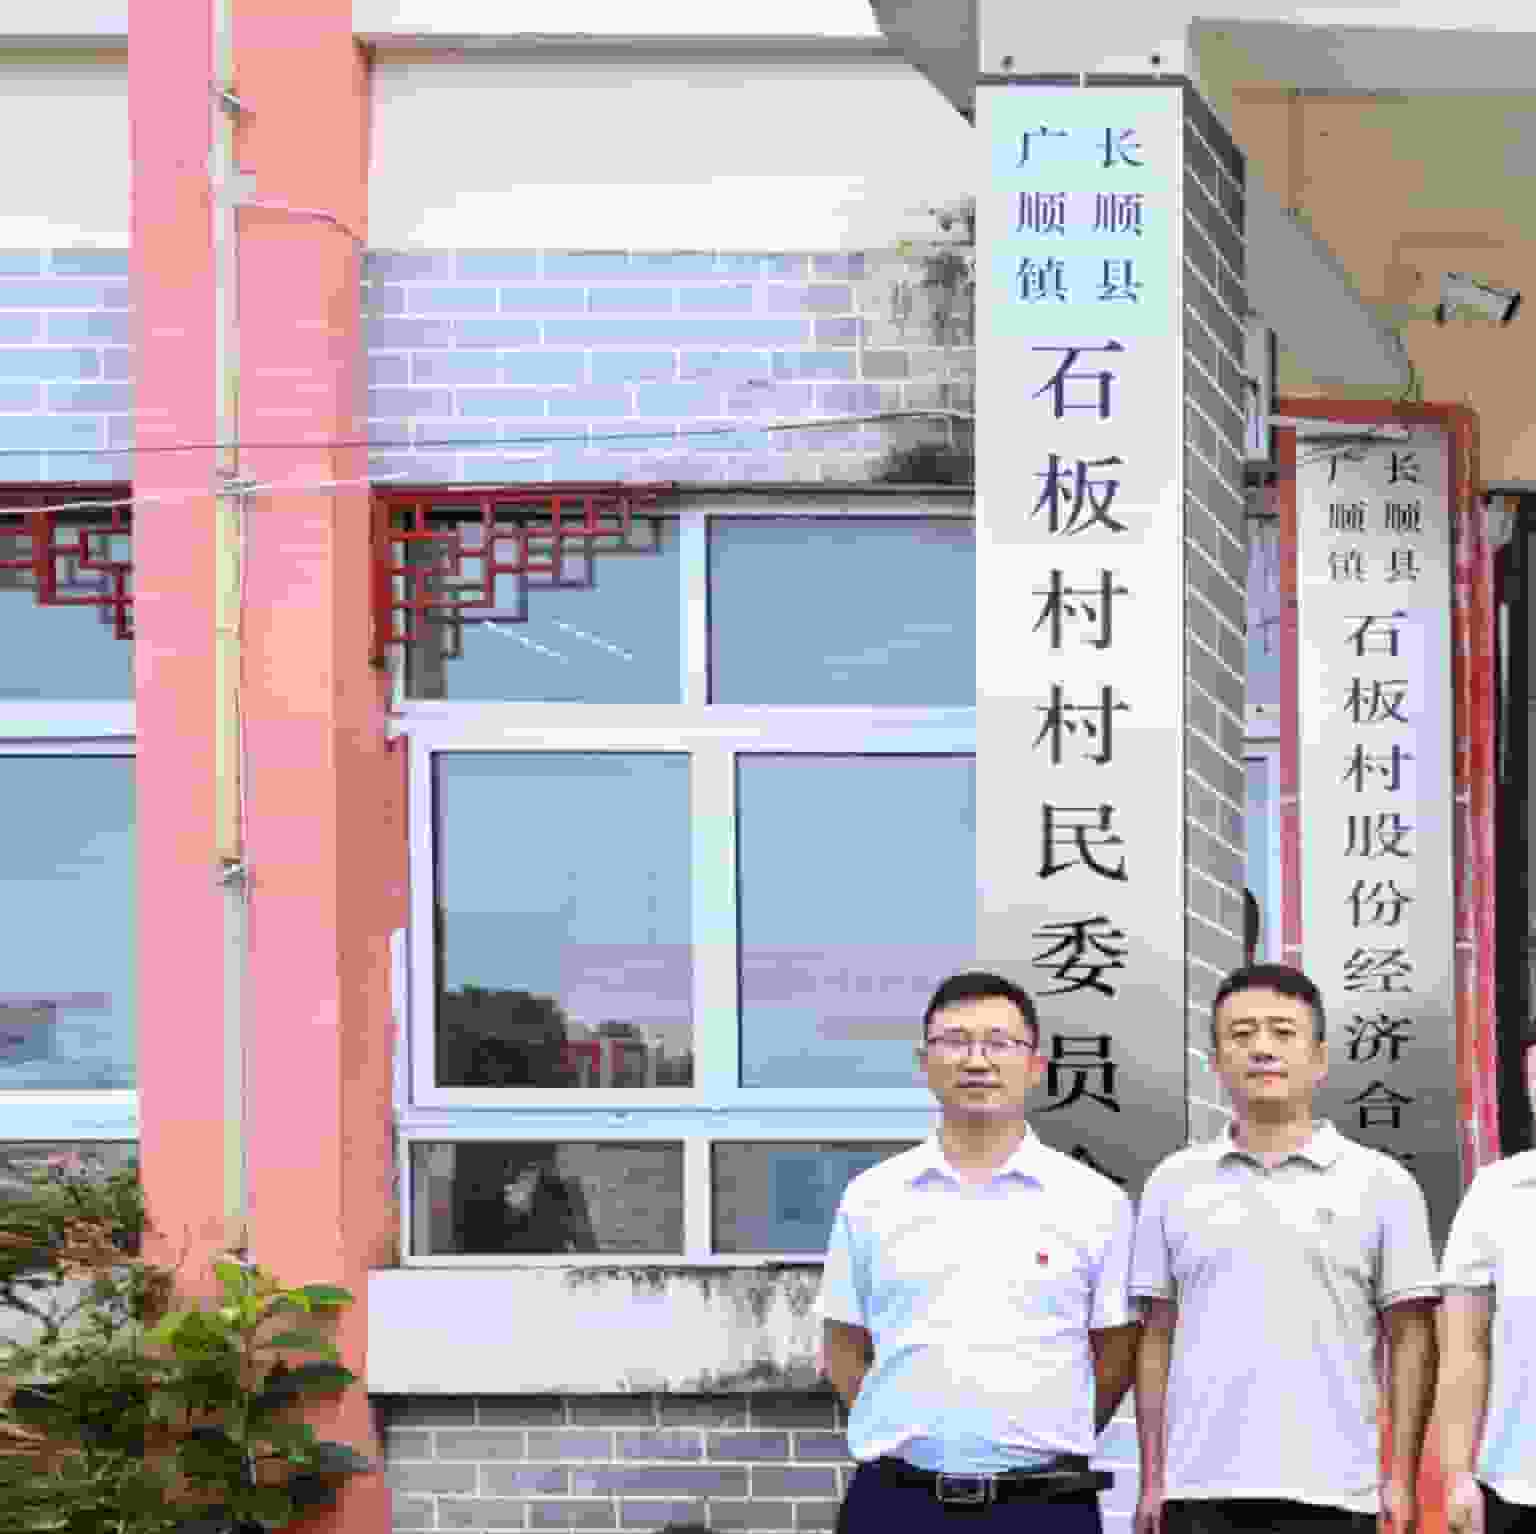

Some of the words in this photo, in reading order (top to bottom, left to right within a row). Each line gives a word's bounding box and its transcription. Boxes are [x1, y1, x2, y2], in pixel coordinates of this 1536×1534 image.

[1015, 125, 1066, 304] 广顺镇
[1095, 125, 1145, 304] 长顺县
[1326, 450, 1366, 584] 广顺镇
[1384, 450, 1422, 582] 长顺县
[1030, 340, 1130, 1185] 石板村村民委员
[1341, 609, 1417, 1164] 石板村股份经济合
